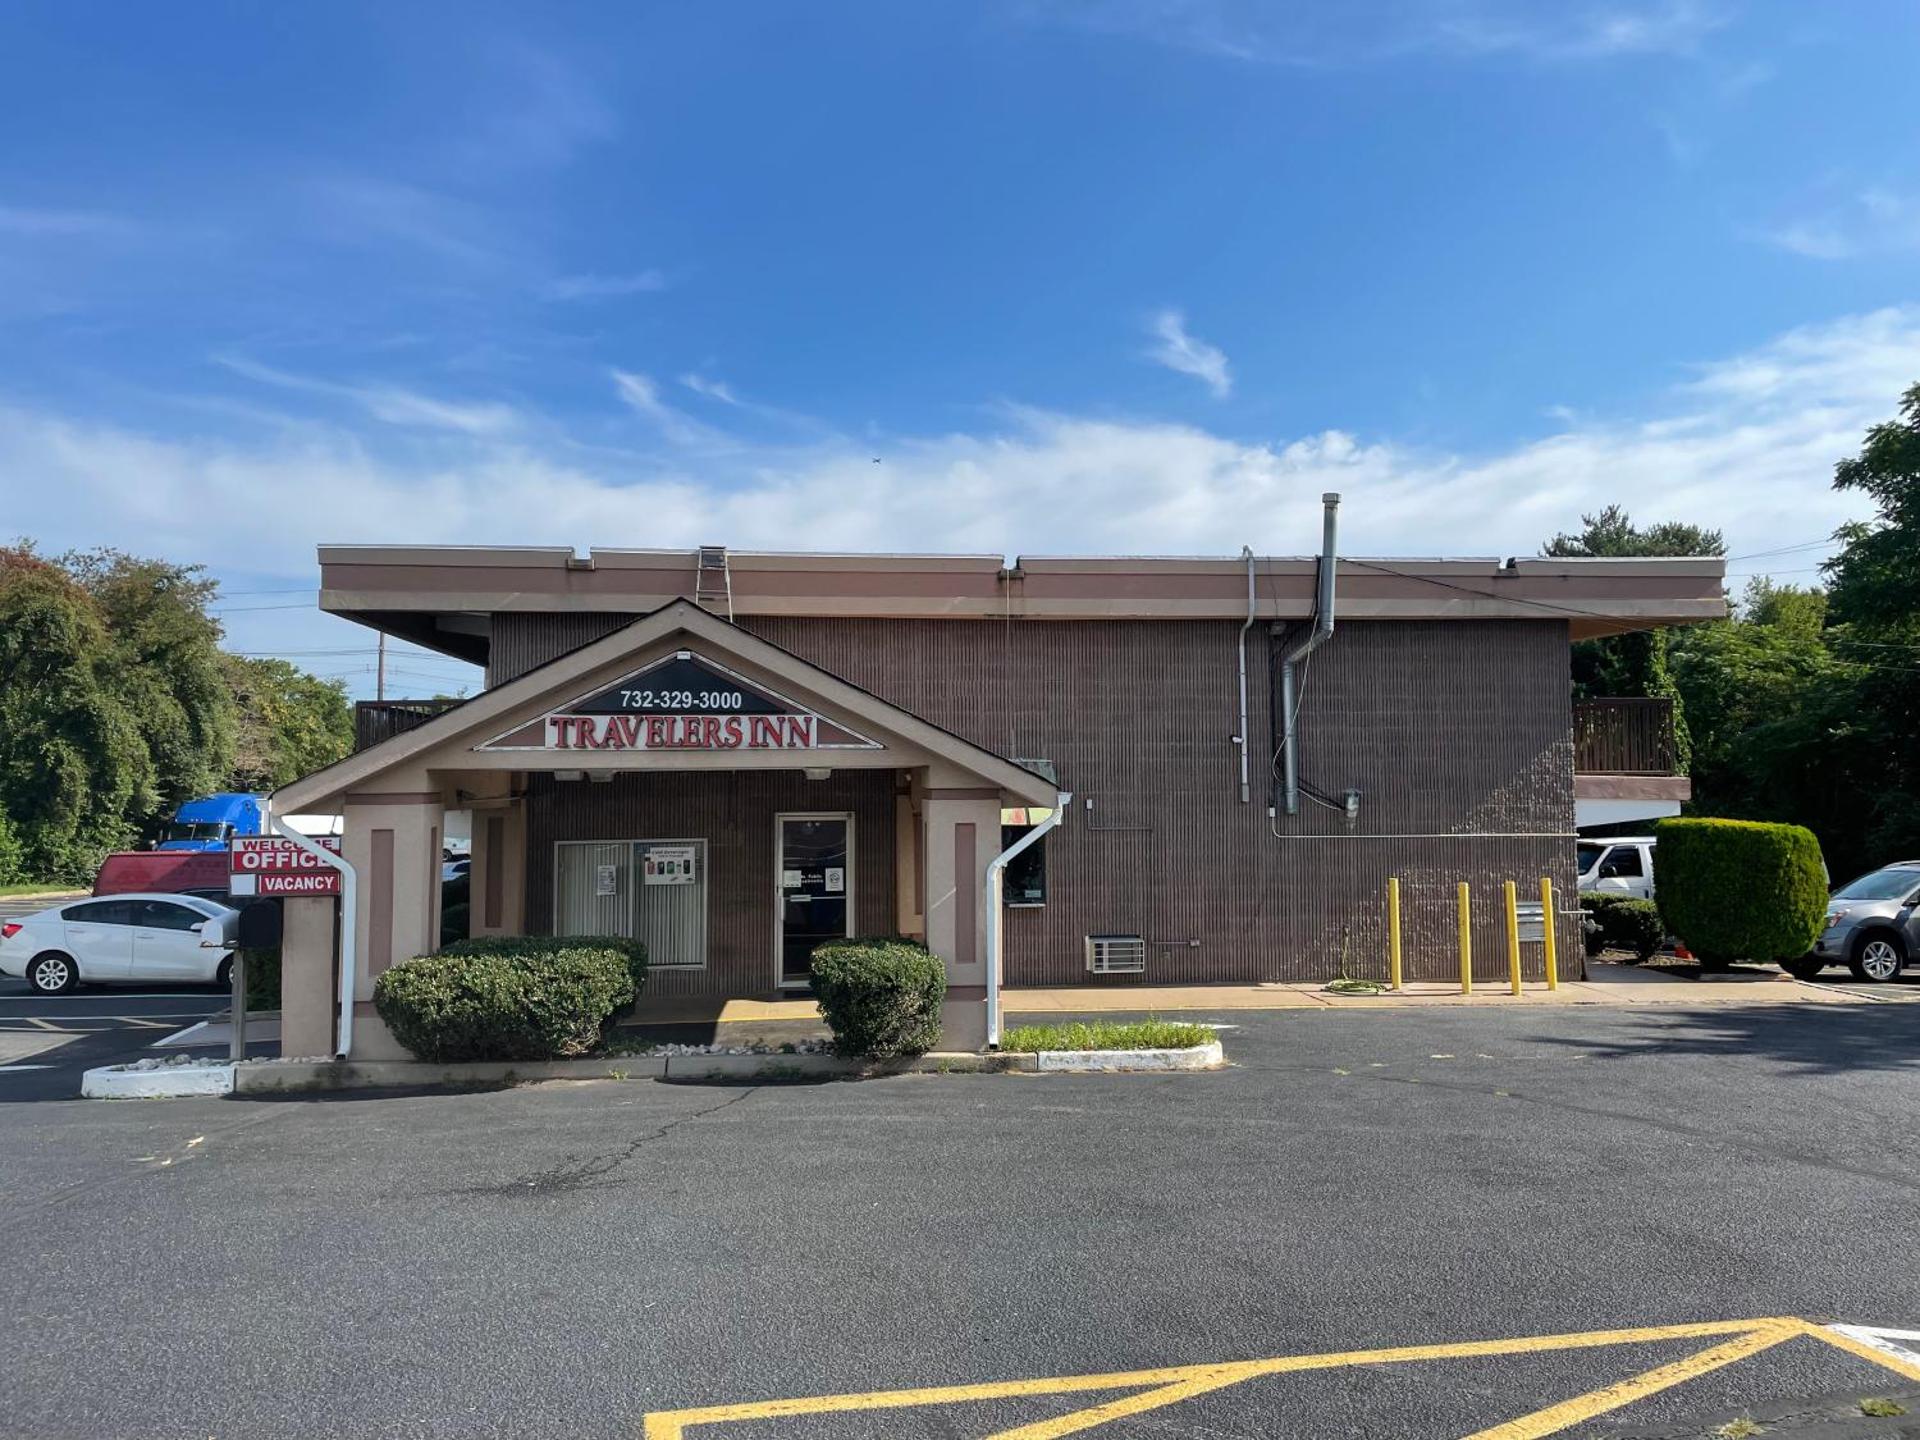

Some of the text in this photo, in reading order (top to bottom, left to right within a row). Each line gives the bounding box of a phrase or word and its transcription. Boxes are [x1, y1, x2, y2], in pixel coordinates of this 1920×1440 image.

[620, 690, 742, 709] 732-329-3000
[550, 716, 813, 750] TRAVELERS INN
[242, 840, 333, 851] WELCE
[264, 876, 335, 891] VACANCY
